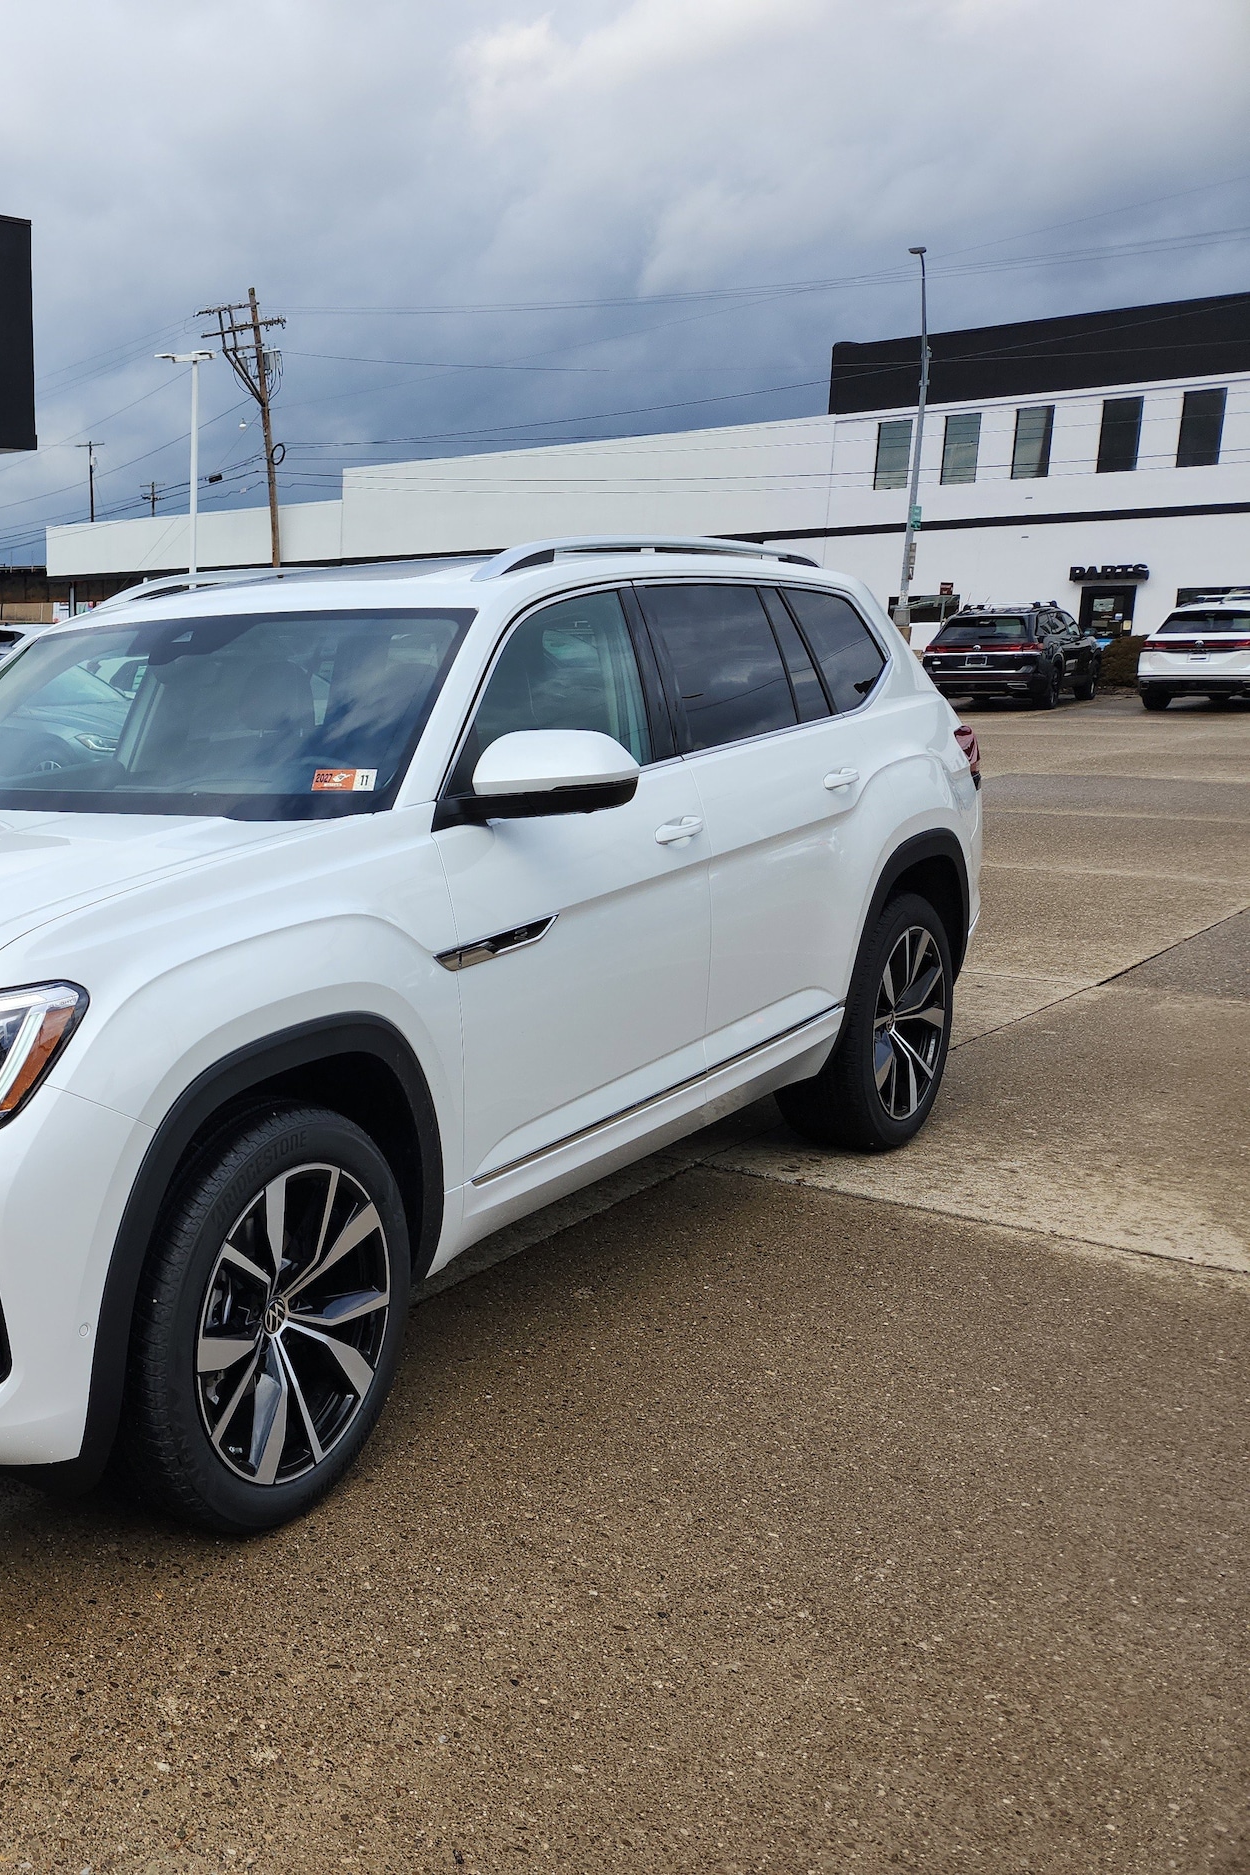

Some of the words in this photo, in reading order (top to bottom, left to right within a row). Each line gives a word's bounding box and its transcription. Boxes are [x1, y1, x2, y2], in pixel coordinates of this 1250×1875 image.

[1069, 563, 1150, 582] PARTS
[315, 773, 333, 783] 2027
[360, 774, 370, 786] 11
